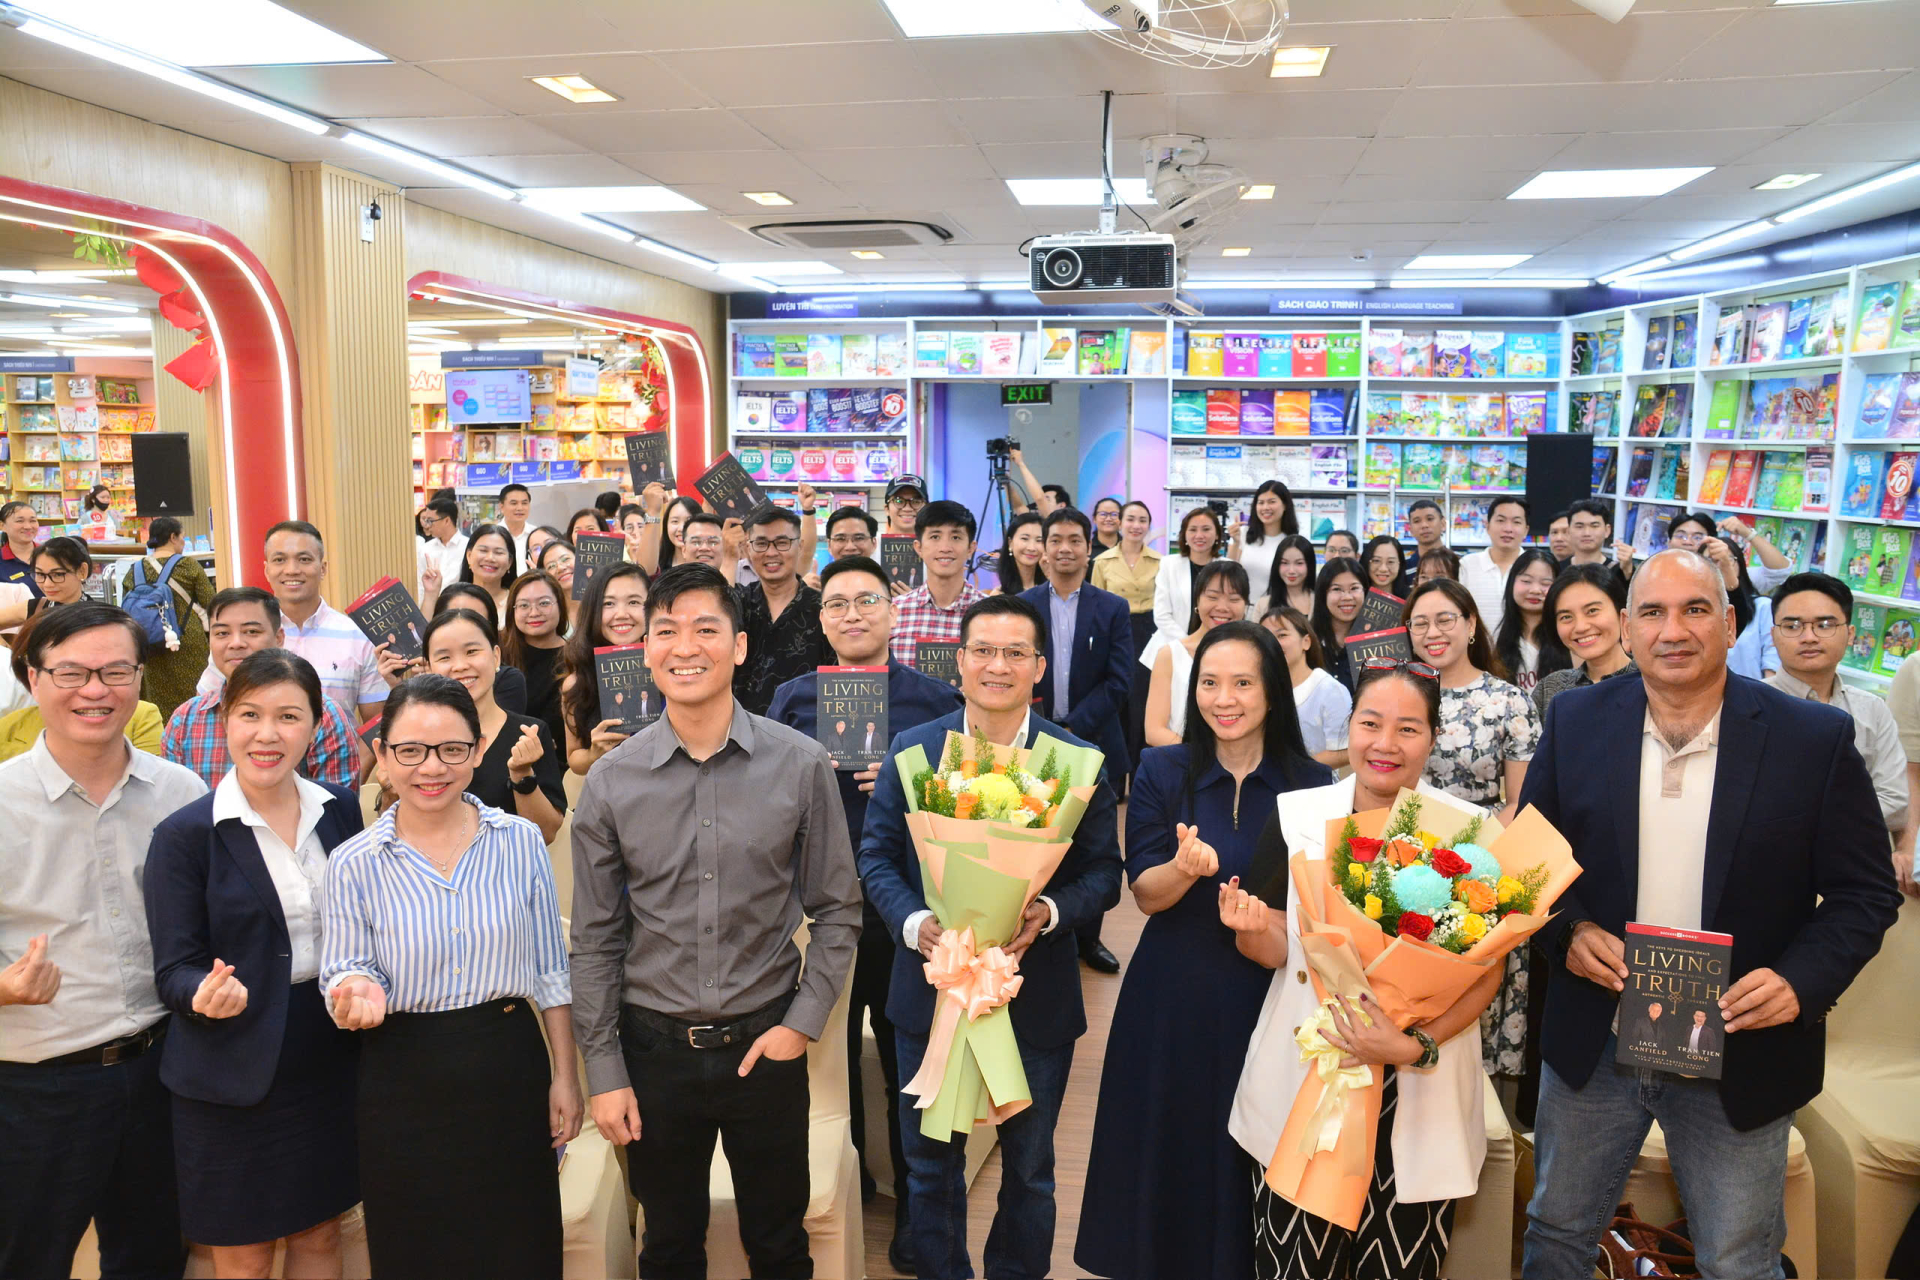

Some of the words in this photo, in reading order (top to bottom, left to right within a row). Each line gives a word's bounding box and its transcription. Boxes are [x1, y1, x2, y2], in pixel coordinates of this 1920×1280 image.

[1191, 339, 1222, 348] LIFE
[1226, 339, 1258, 348] LIFE
[1259, 339, 1291, 348] LIFE
[1294, 339, 1326, 348] LIFE
[1327, 339, 1360, 348] LIFE
[1007, 386, 1046, 401] EXIT
[885, 400, 900, 414] 10
[1798, 396, 1813, 412] 10
[1208, 414, 1238, 422] Solutions
[1242, 414, 1273, 422] Solutions
[629, 440, 666, 451] LIVING
[631, 449, 668, 461] TRUTH
[741, 456, 762, 464] IELTS
[772, 456, 792, 464] IELTS
[804, 456, 824, 464] IELTS
[835, 456, 857, 464] IELTS
[702, 462, 738, 495] LIVING
[1890, 470, 1908, 492] 10
[710, 471, 747, 503] TRUTH
[1853, 528, 1871, 540] Kid's
[1882, 532, 1900, 545] Kid's
[580, 542, 620, 554] LIVING
[884, 544, 913, 552] LIVIN
[1857, 539, 1871, 549] Box
[1886, 543, 1900, 553] Box
[362, 592, 404, 625] LIVING
[1366, 598, 1400, 618] LIVING
[1858, 607, 1875, 620] Kid's
[369, 603, 413, 636] TRUTH
[1363, 608, 1398, 629] TRUTH
[1860, 617, 1875, 628] Box
[920, 650, 954, 660] LIVIN
[1354, 642, 1406, 662] LIVING
[602, 673, 654, 688] TRUTH
[1518, 671, 1539, 689] RO
[824, 683, 883, 696] LIVING
[823, 701, 883, 714] TRUTH
[1634, 949, 1722, 975] LIVING
[1657, 970, 1687, 978] EXPECTATIONS
[1632, 972, 1720, 1000] TRUTH
[1639, 1040, 1658, 1048] JACK
[1629, 1045, 1667, 1056] CANFIELD
[1677, 1046, 1699, 1054] TRAN
[1702, 1049, 1720, 1057] TIEN
[1686, 1054, 1709, 1062] CONG
